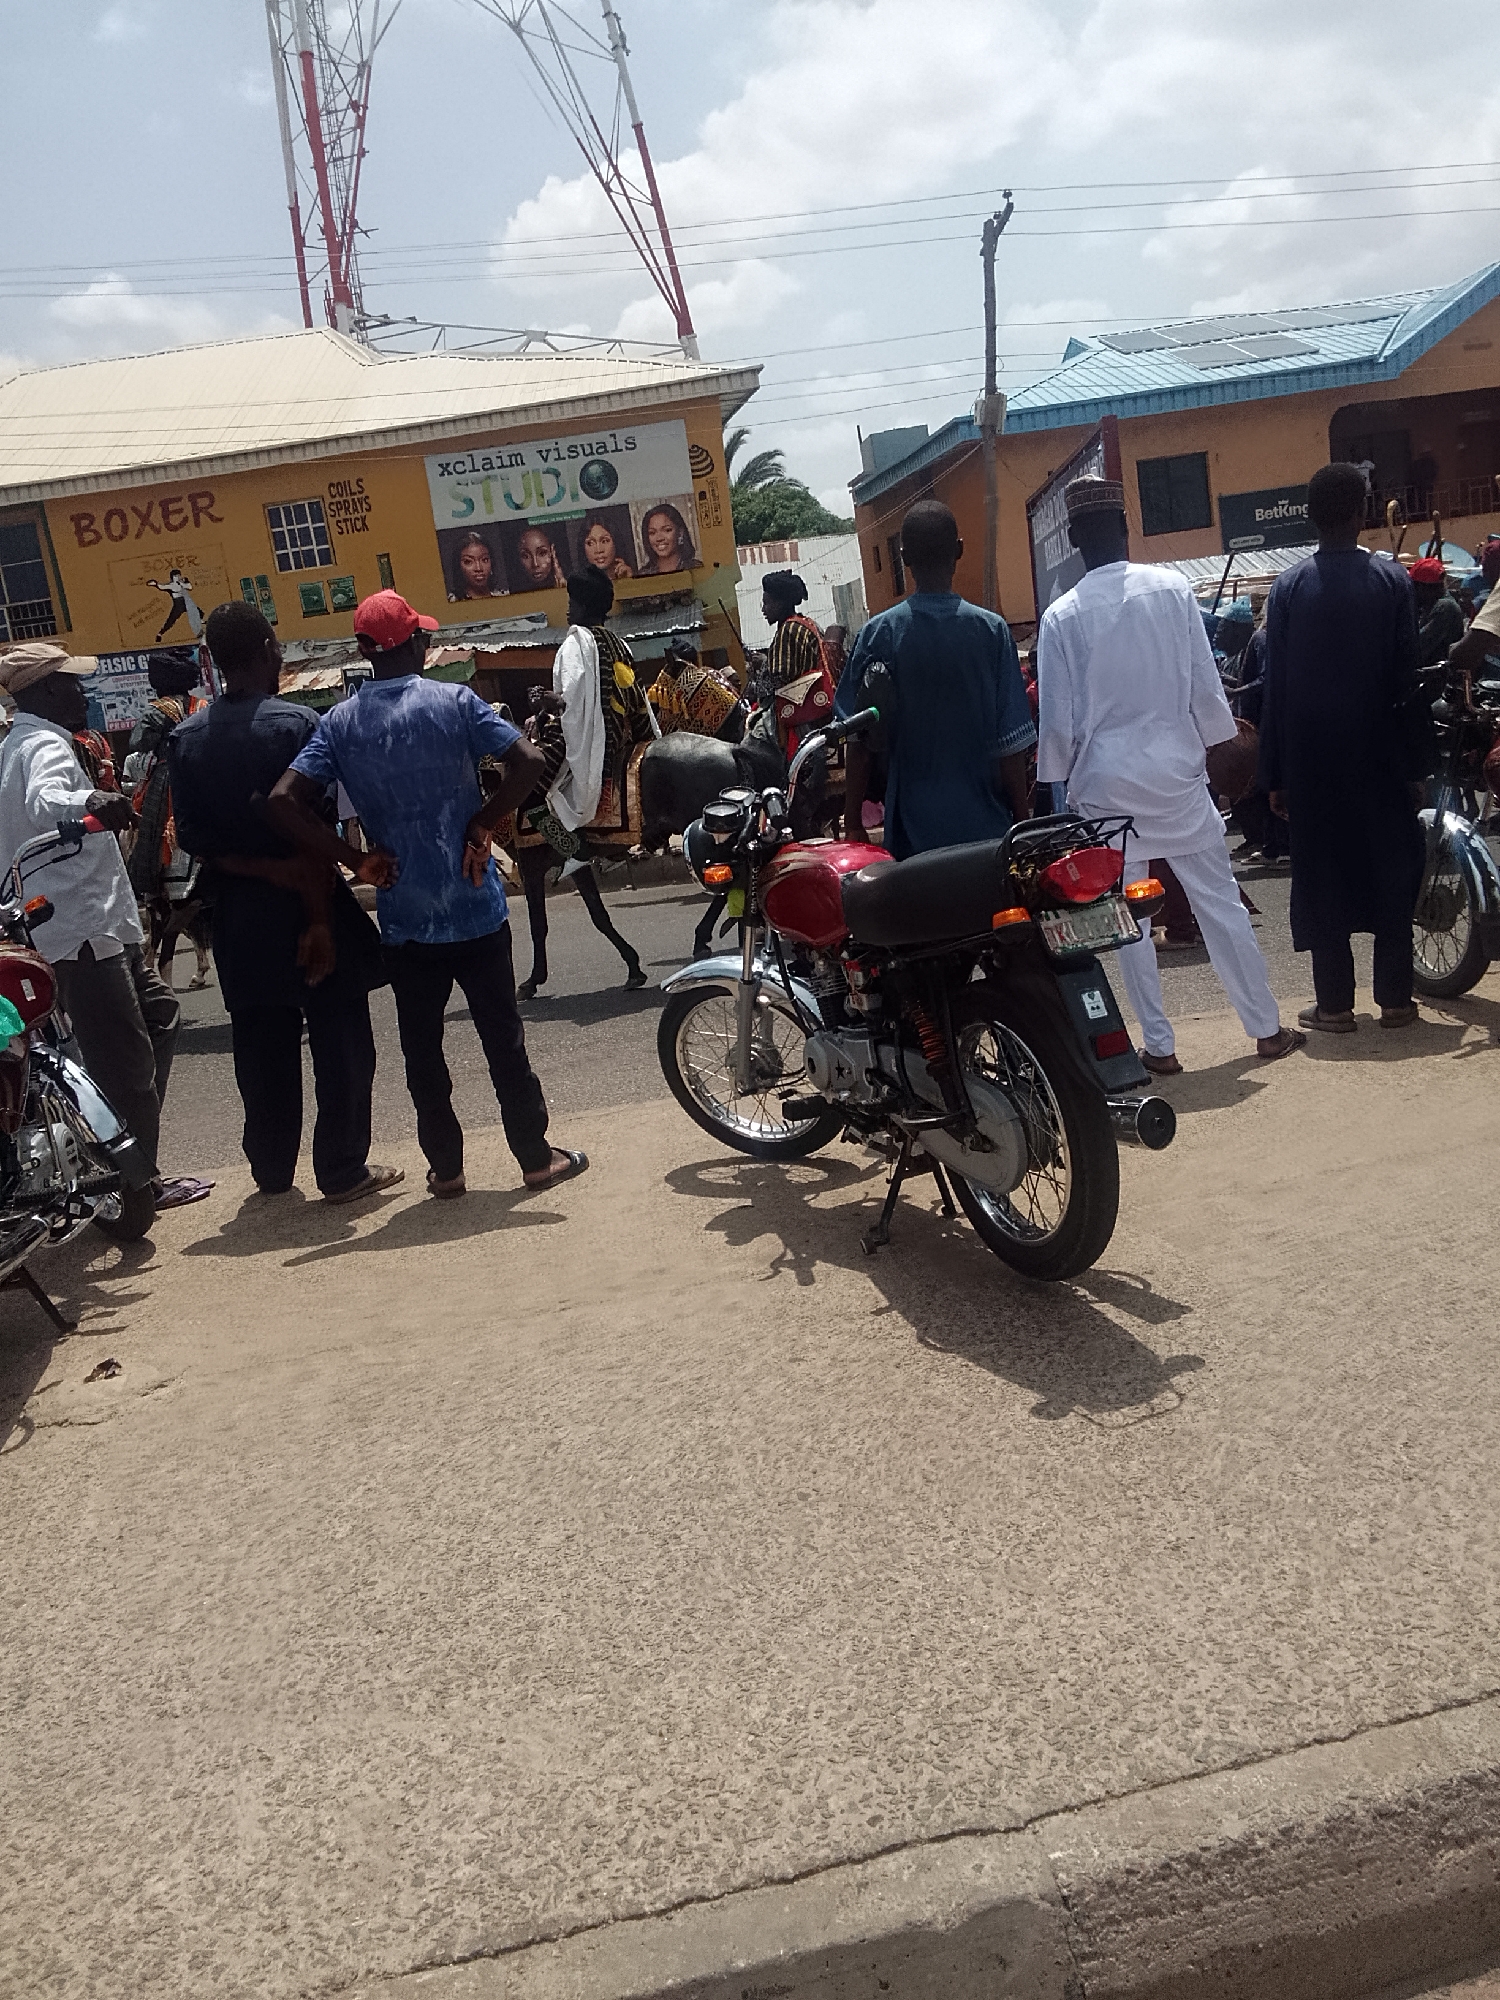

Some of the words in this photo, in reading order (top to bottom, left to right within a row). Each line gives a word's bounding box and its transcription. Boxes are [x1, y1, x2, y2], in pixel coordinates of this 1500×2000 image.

[438, 451, 526, 477] xclaim
[536, 433, 637, 463] visuals
[328, 477, 365, 499] COILS
[328, 495, 372, 518] SPRAYS
[69, 490, 225, 548] BOXER
[336, 514, 370, 535] STICK
[96, 656, 136, 675] ELSIC
